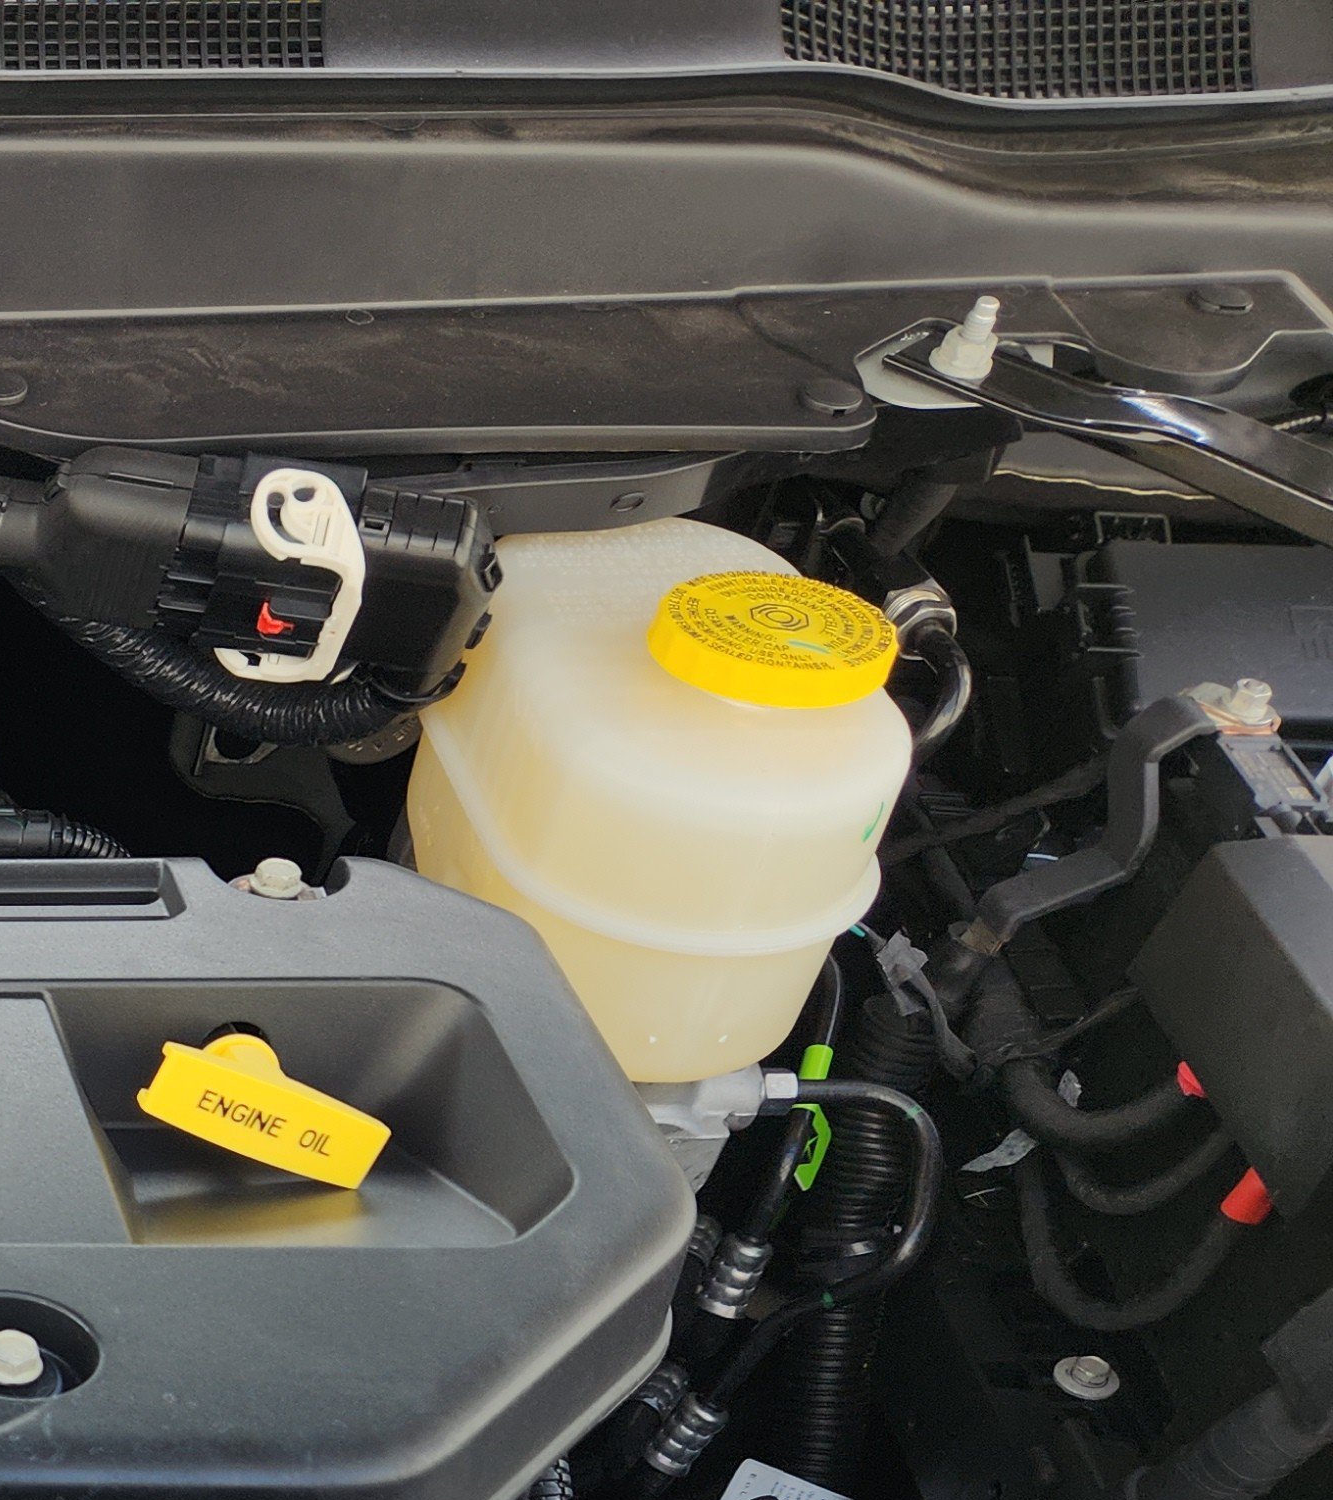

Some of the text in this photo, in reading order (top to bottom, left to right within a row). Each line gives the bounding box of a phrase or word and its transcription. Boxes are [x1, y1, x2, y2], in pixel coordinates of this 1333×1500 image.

[707, 643, 754, 662] SEALED
[749, 647, 774, 658] USE
[779, 654, 813, 662] ONLY
[763, 643, 790, 652] CAP
[195, 1088, 332, 1158] ENGINE OIL
